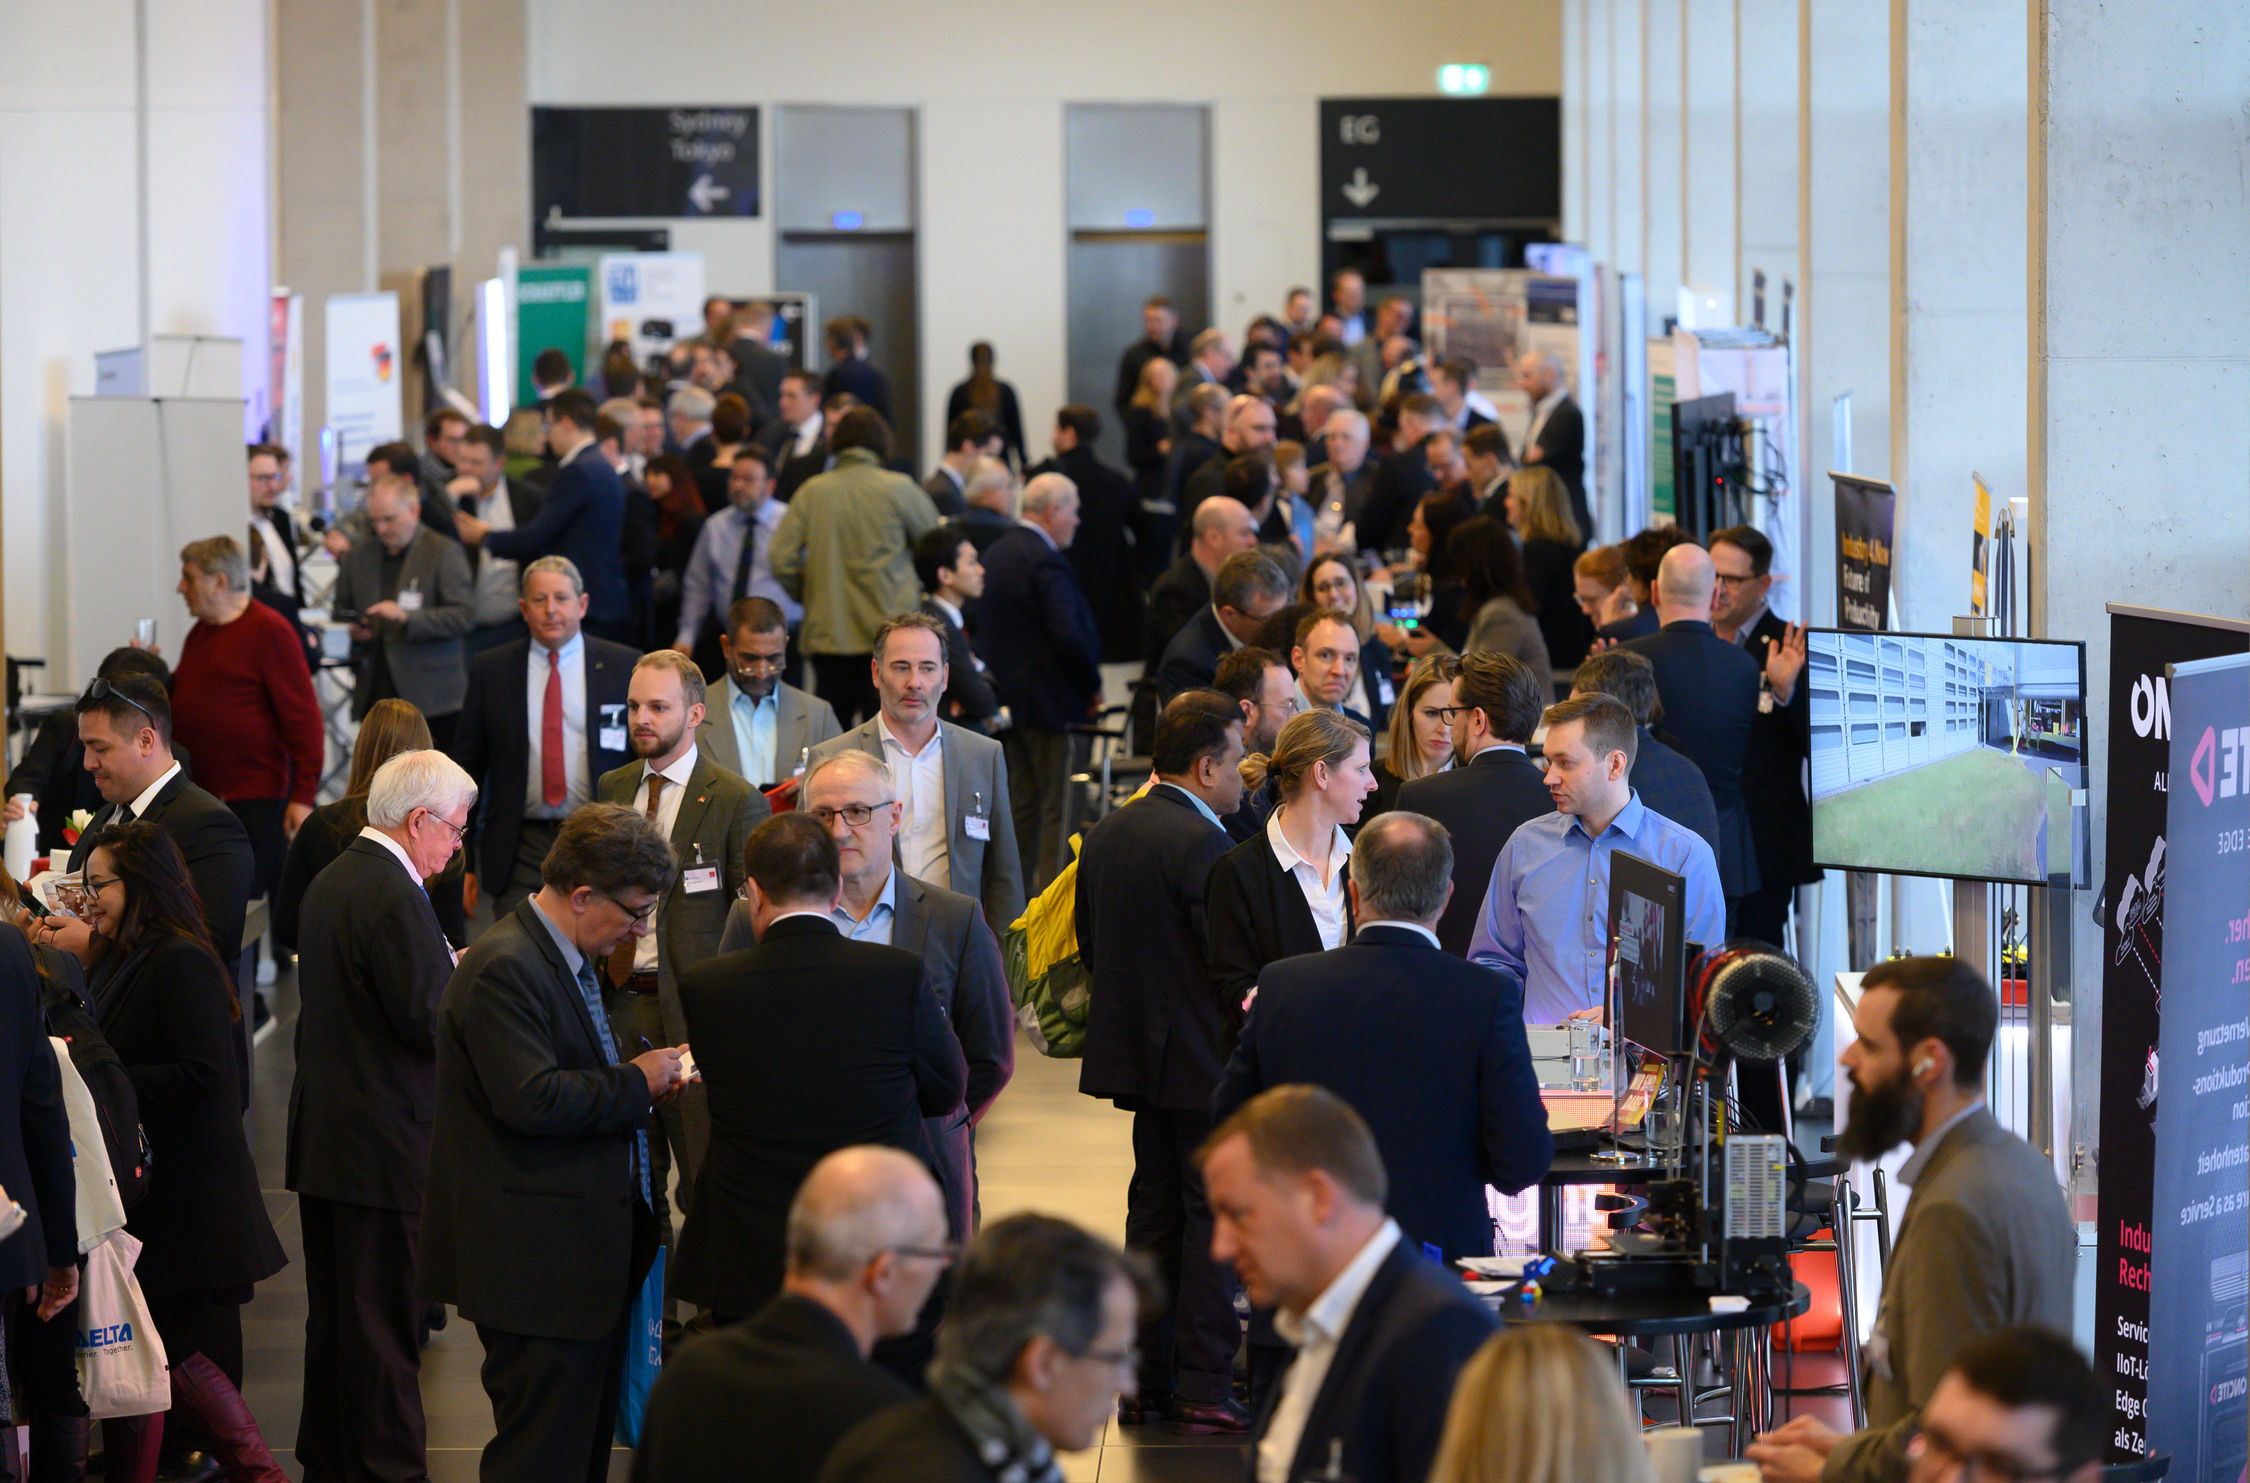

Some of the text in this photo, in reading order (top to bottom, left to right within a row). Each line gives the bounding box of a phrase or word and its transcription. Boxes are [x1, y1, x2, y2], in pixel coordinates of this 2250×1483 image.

[1339, 115, 1381, 144] EG
[2120, 1219, 2151, 1254] Indu
[2120, 1257, 2151, 1293] Rech
[2117, 1315, 2149, 1344] Servic
[2115, 1389, 2140, 1420] Edge
[2114, 1426, 2147, 1455] als Ze
